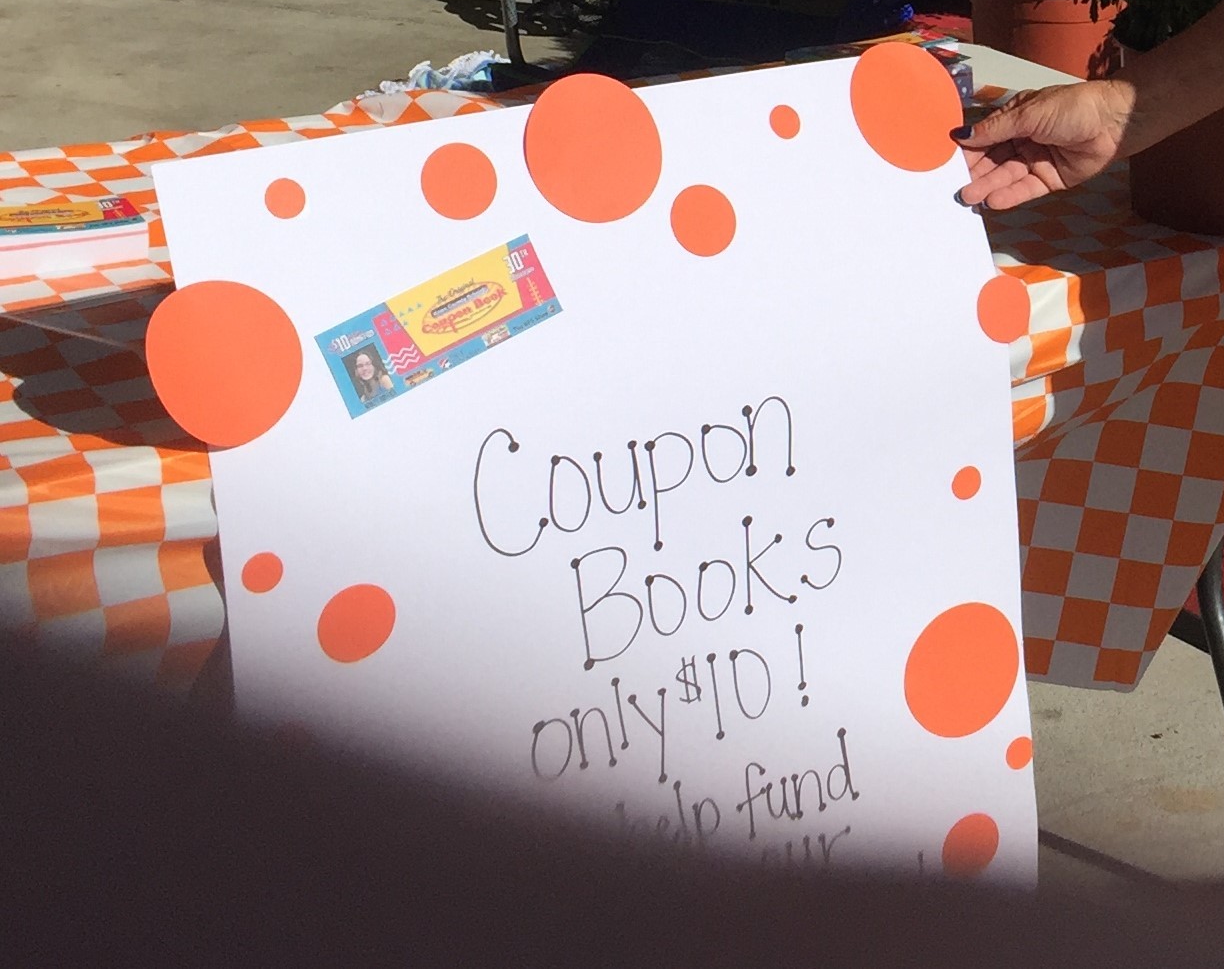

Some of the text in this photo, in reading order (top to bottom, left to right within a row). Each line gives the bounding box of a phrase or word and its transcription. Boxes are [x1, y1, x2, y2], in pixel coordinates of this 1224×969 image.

[422, 306, 474, 334] Coupon
[473, 287, 508, 310] Book
[474, 395, 796, 557] Coupon
[570, 515, 842, 671] Books
[531, 677, 669, 784] only
[735, 727, 861, 839] fund
